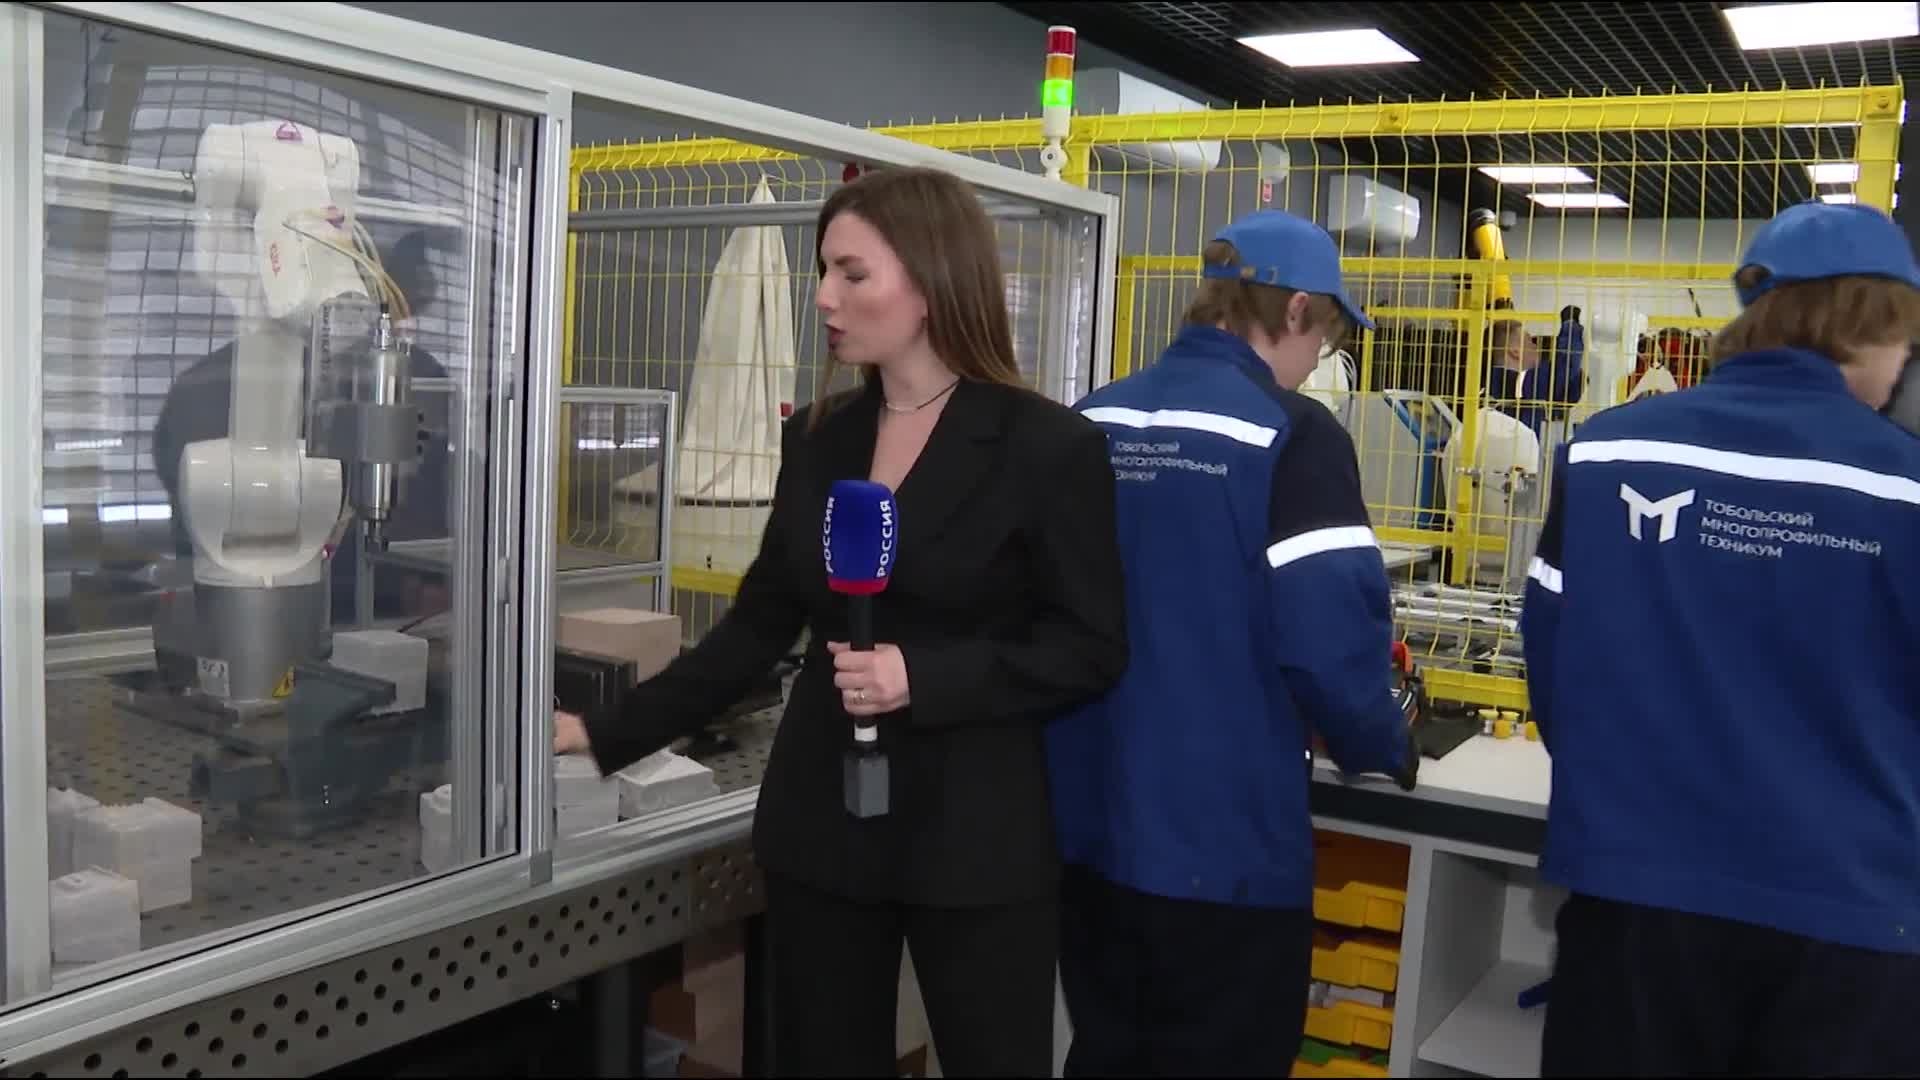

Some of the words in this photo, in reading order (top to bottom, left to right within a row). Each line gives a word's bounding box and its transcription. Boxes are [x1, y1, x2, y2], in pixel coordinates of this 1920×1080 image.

[1705, 499, 1814, 527] ТОБОЛЬСКИЙ
[822, 496, 835, 573] РОССИЯ
[876, 499, 894, 578] РОССИЯ
[1699, 533, 1783, 558] ТЕХНИКУМ
[1700, 516, 1882, 556] МНОГОПРОФИЛЬНЫЙ
